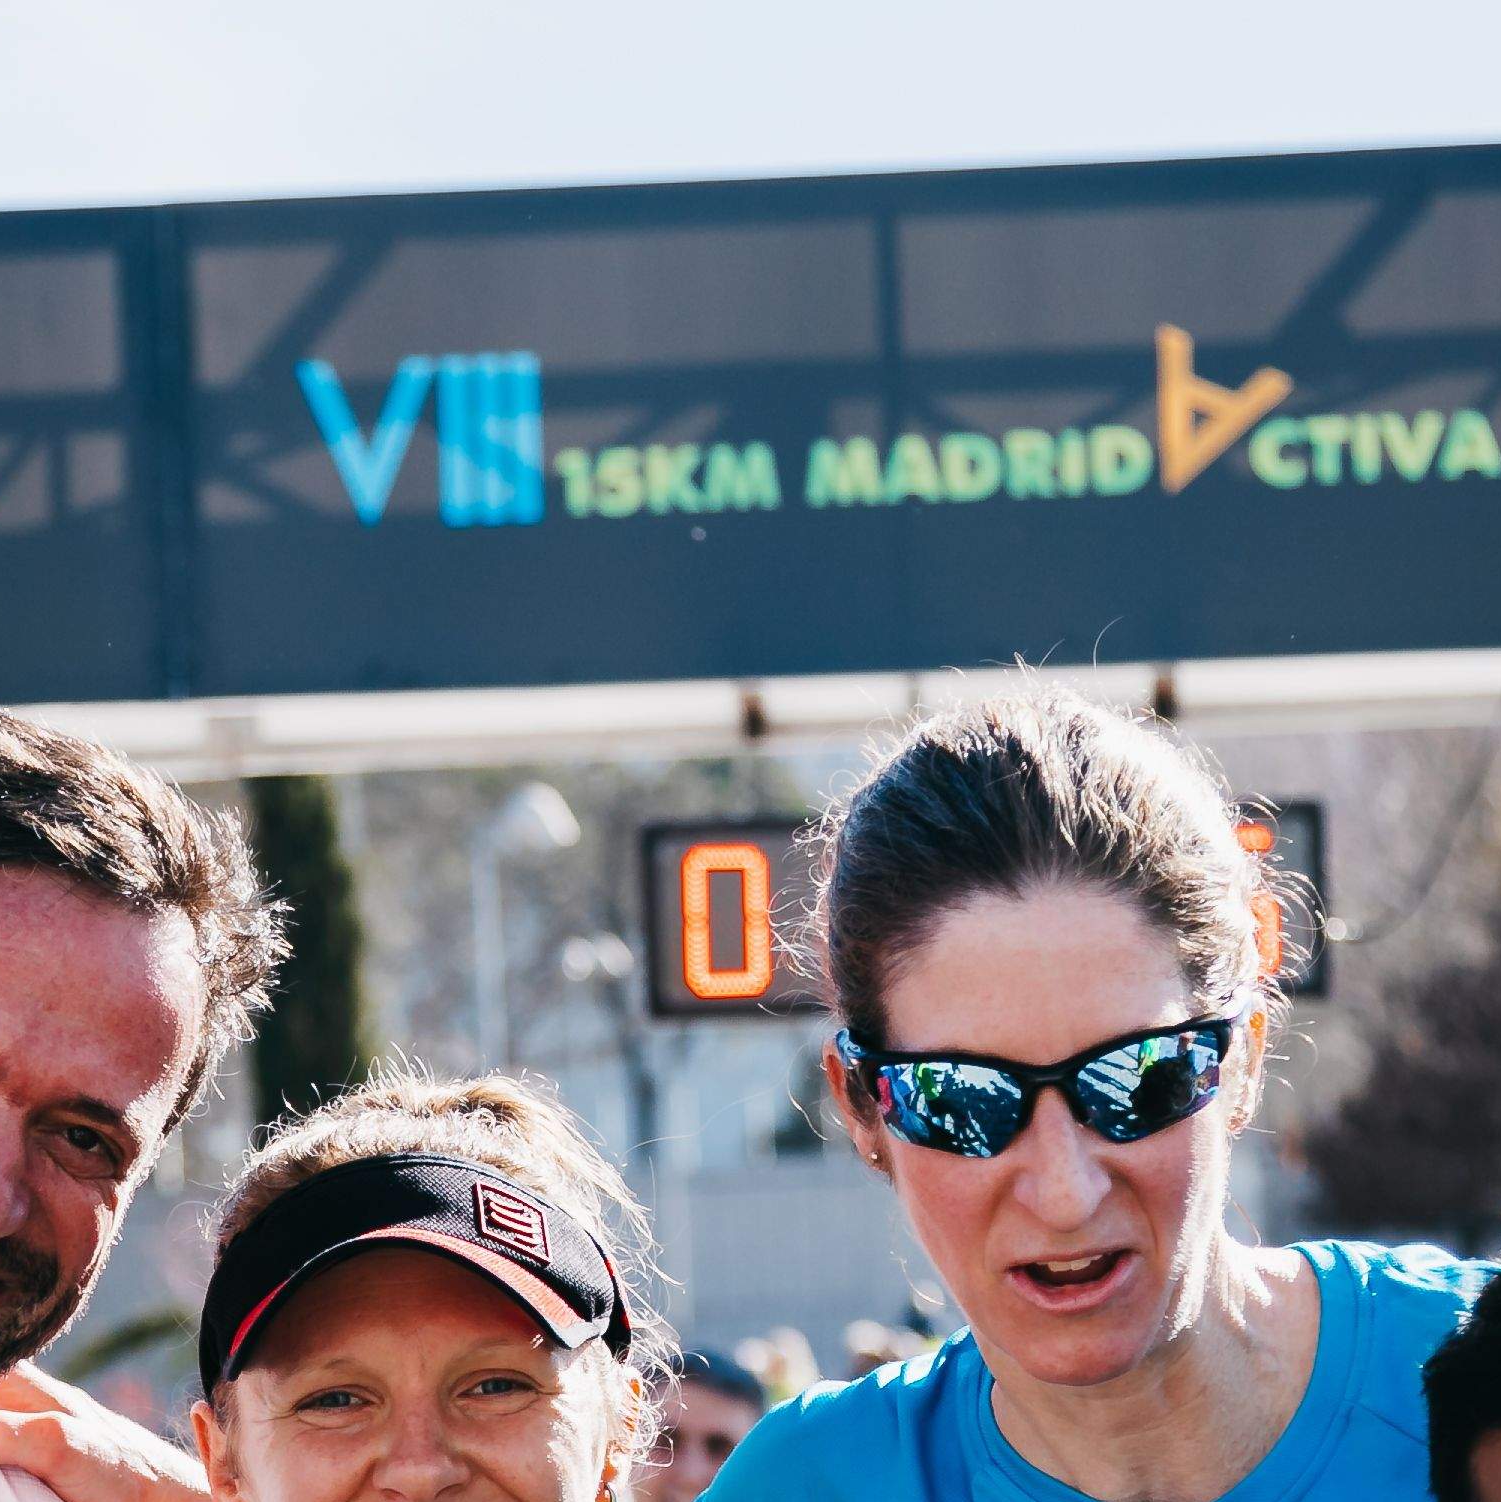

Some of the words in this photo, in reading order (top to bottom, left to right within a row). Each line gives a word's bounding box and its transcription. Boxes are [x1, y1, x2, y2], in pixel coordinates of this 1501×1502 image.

[298, 352, 544, 528] VIII
[557, 442, 779, 519] 15KM
[805, 425, 1154, 509] MADRID
